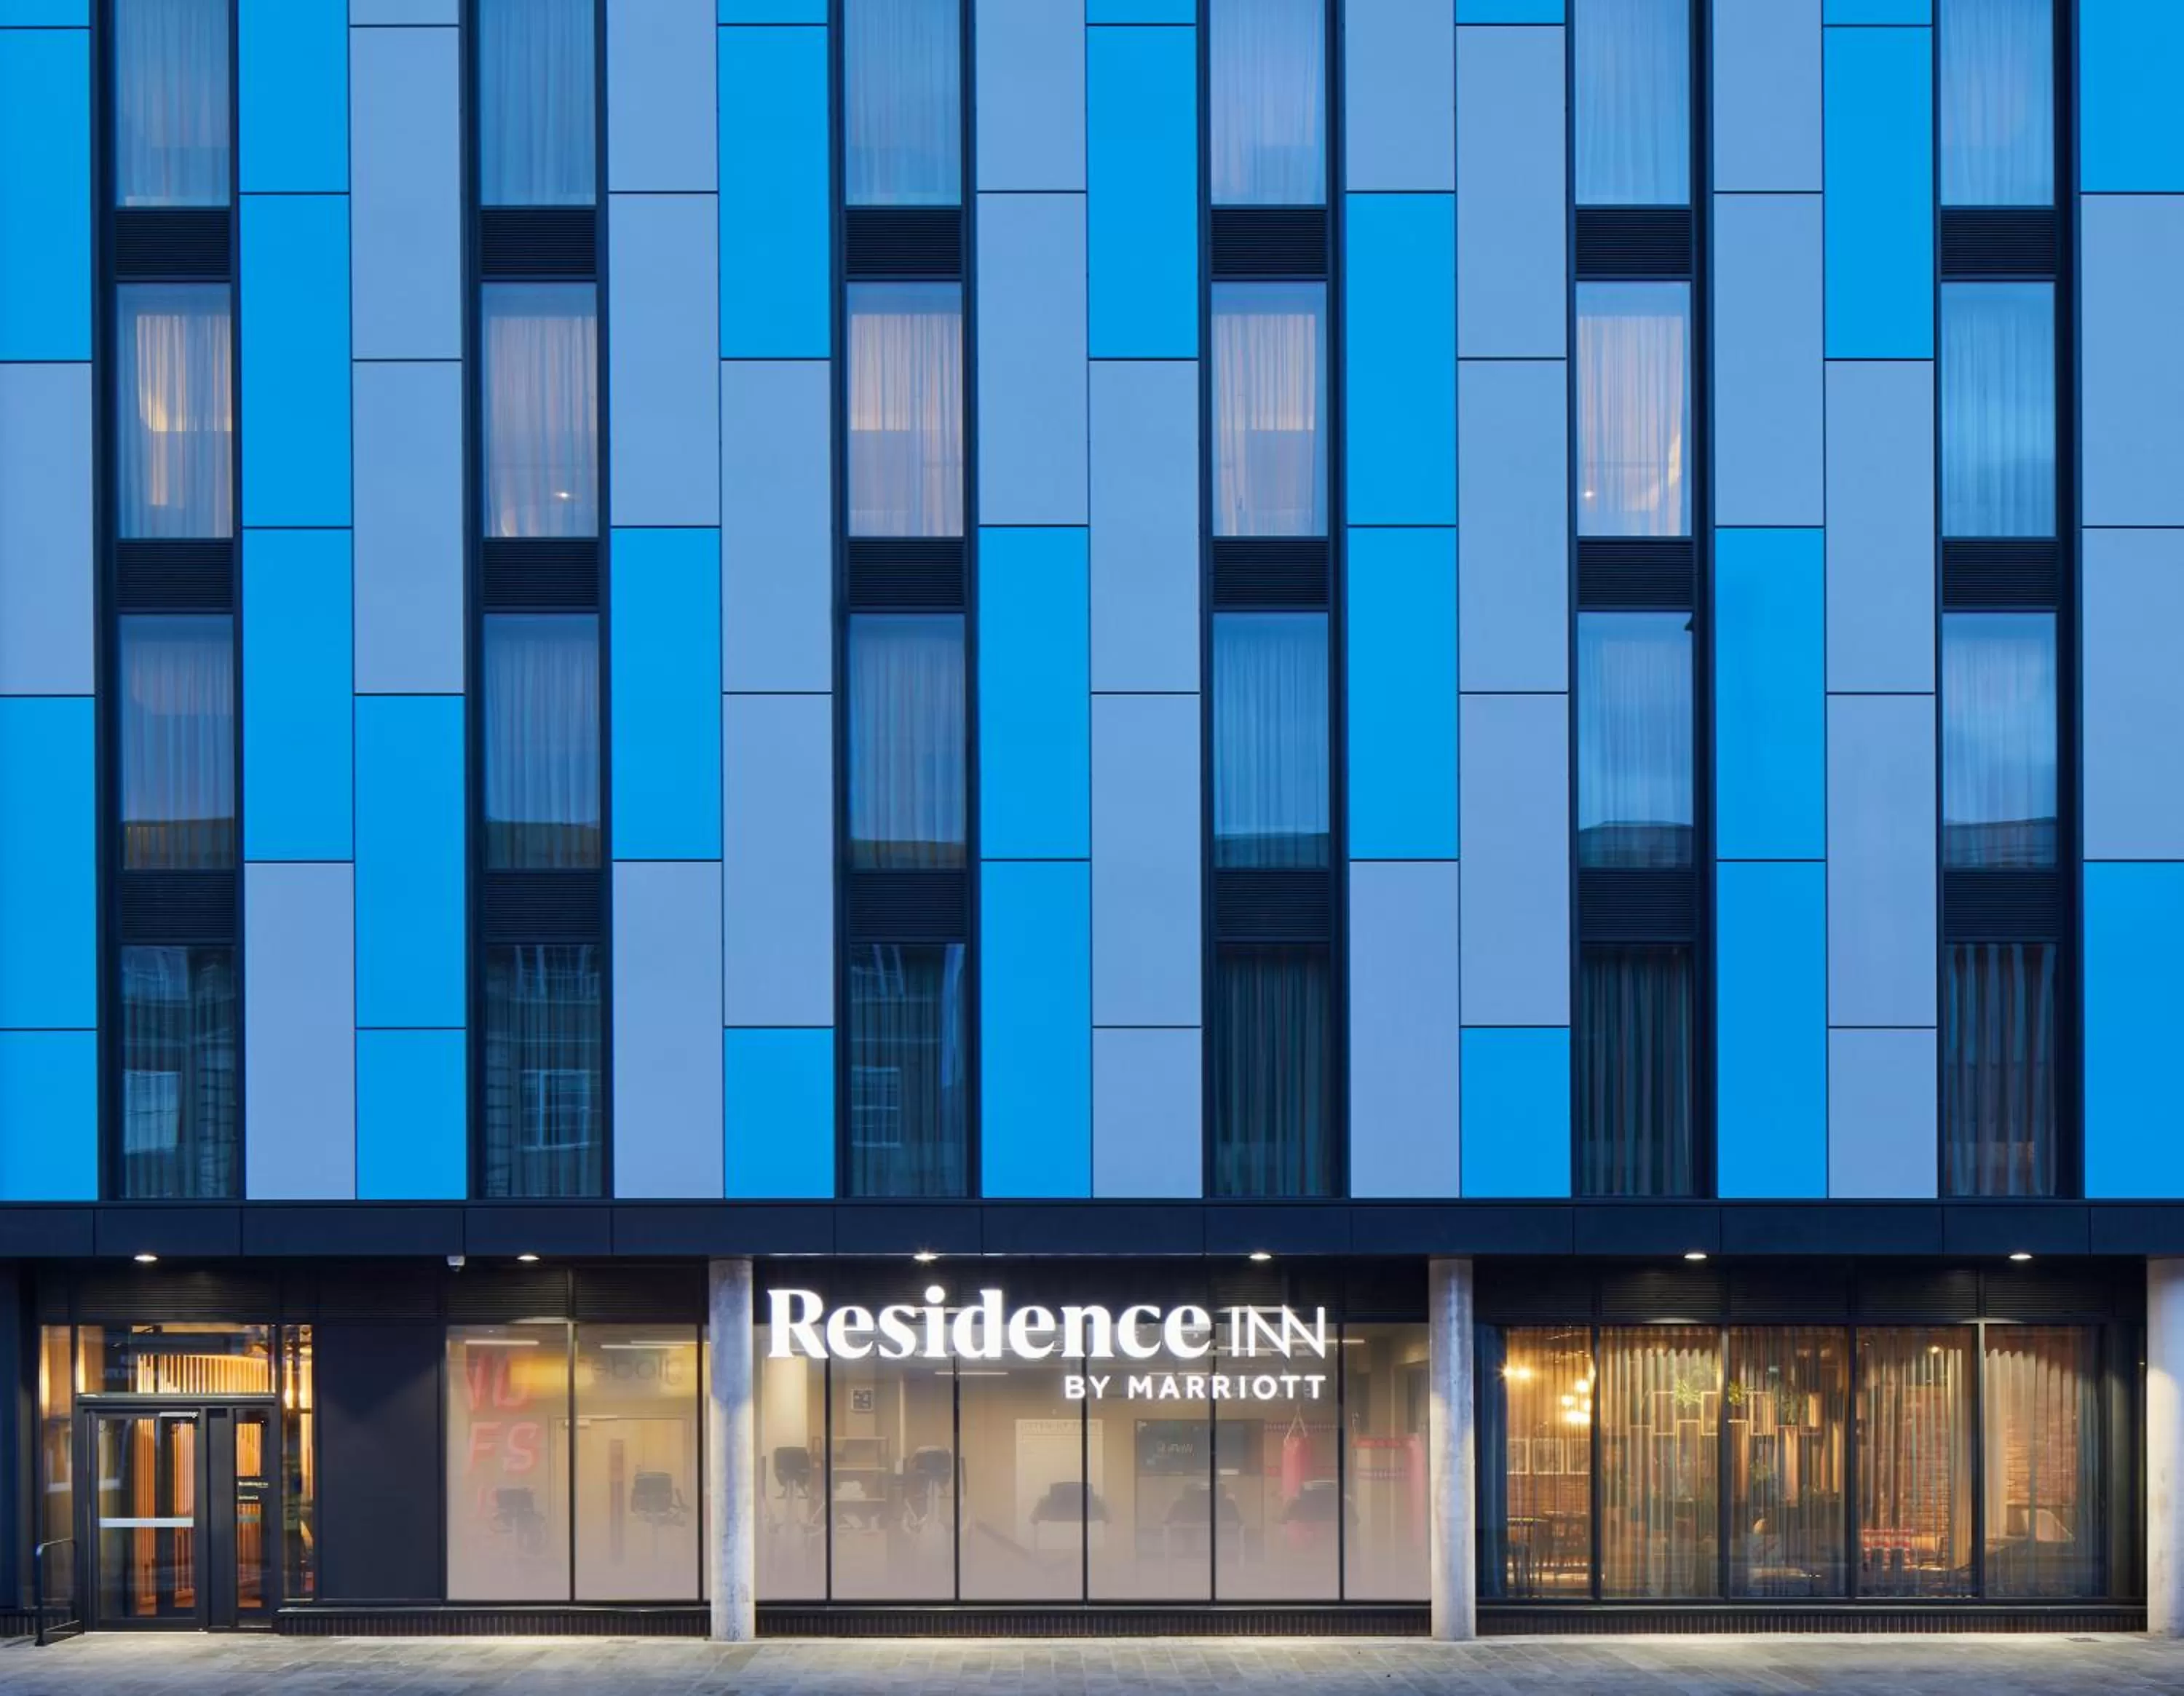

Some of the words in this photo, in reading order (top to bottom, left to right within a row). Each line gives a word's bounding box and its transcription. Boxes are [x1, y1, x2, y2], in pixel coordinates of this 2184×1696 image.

[767, 1285, 1211, 1360] Residence
[1230, 1305, 1326, 1358] INN
[1064, 1374, 1110, 1400] BY
[1127, 1374, 1326, 1400] MARRIOTT
